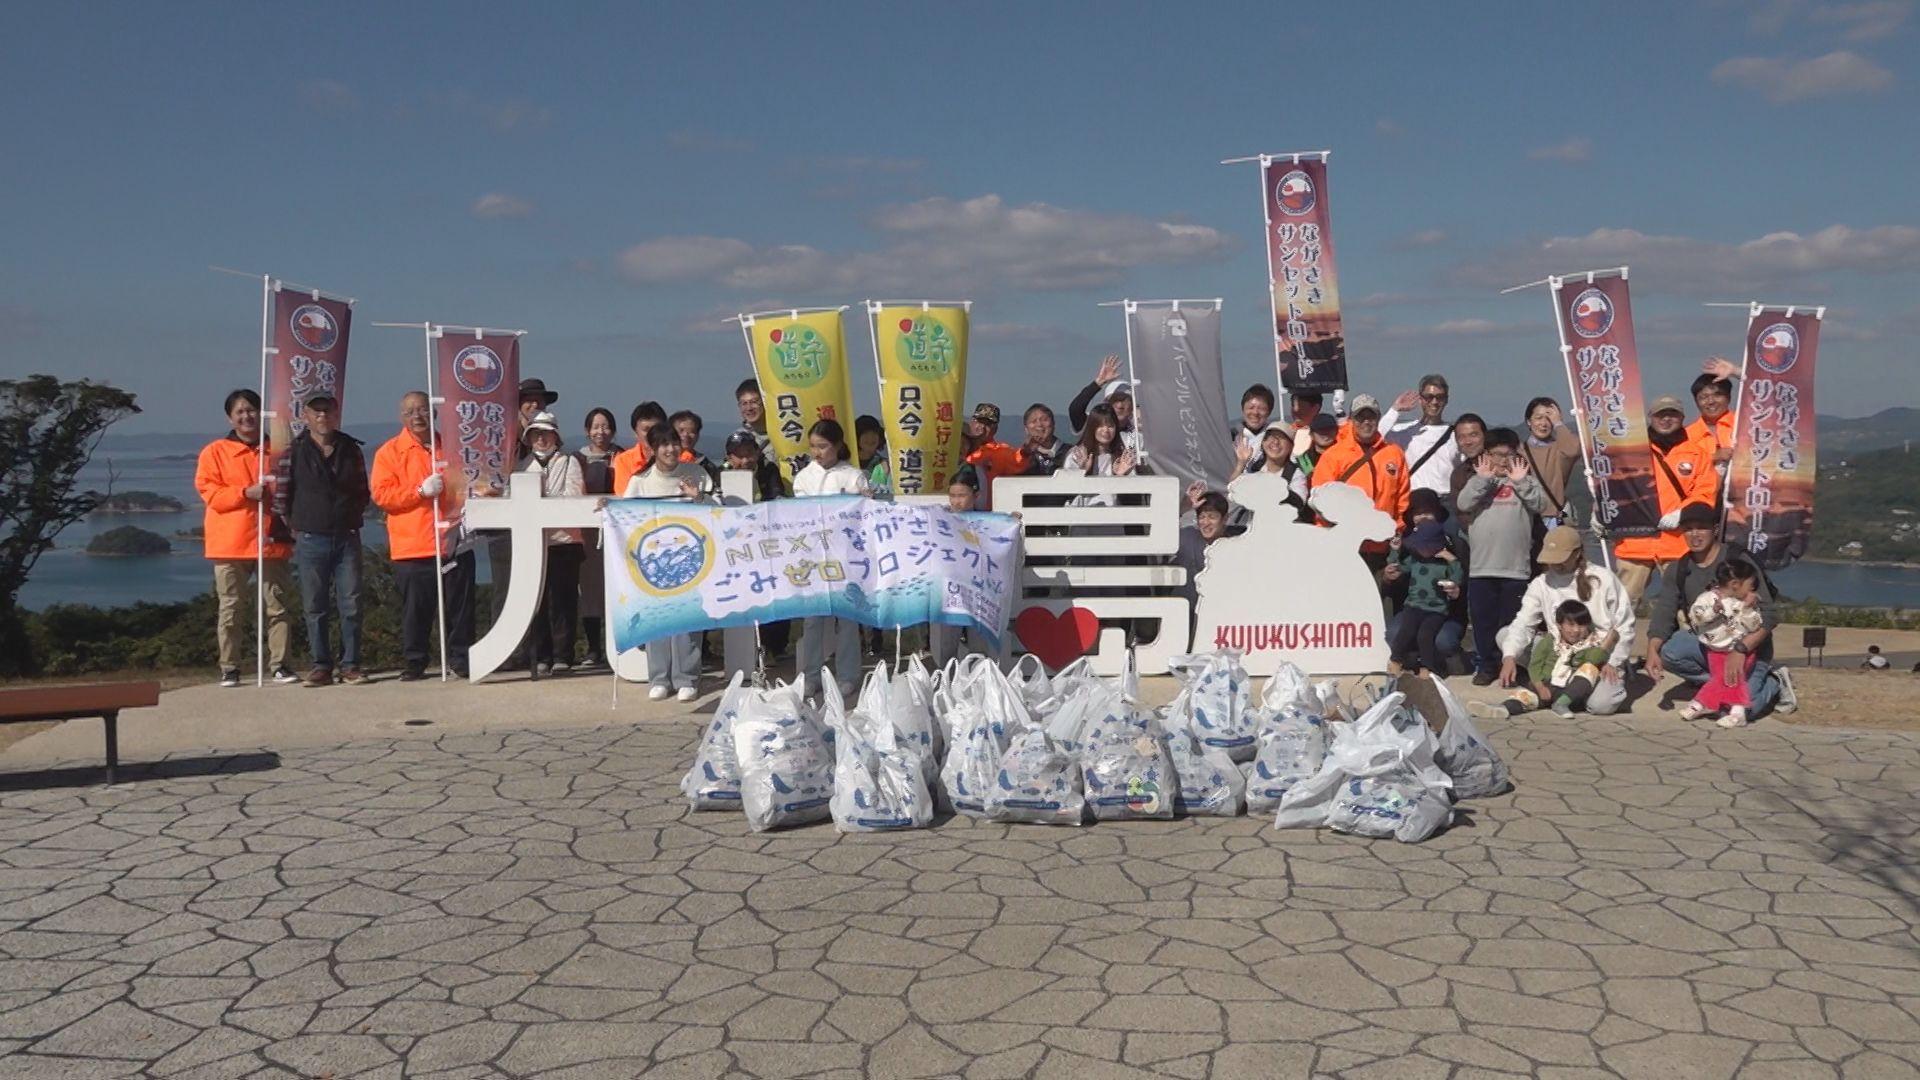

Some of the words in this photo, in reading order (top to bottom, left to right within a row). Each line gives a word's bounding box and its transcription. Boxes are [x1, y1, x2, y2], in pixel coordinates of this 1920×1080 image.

[1576, 345, 1619, 524] サンセットロード
[1213, 621, 1373, 655] KUJUKUSHIMA
